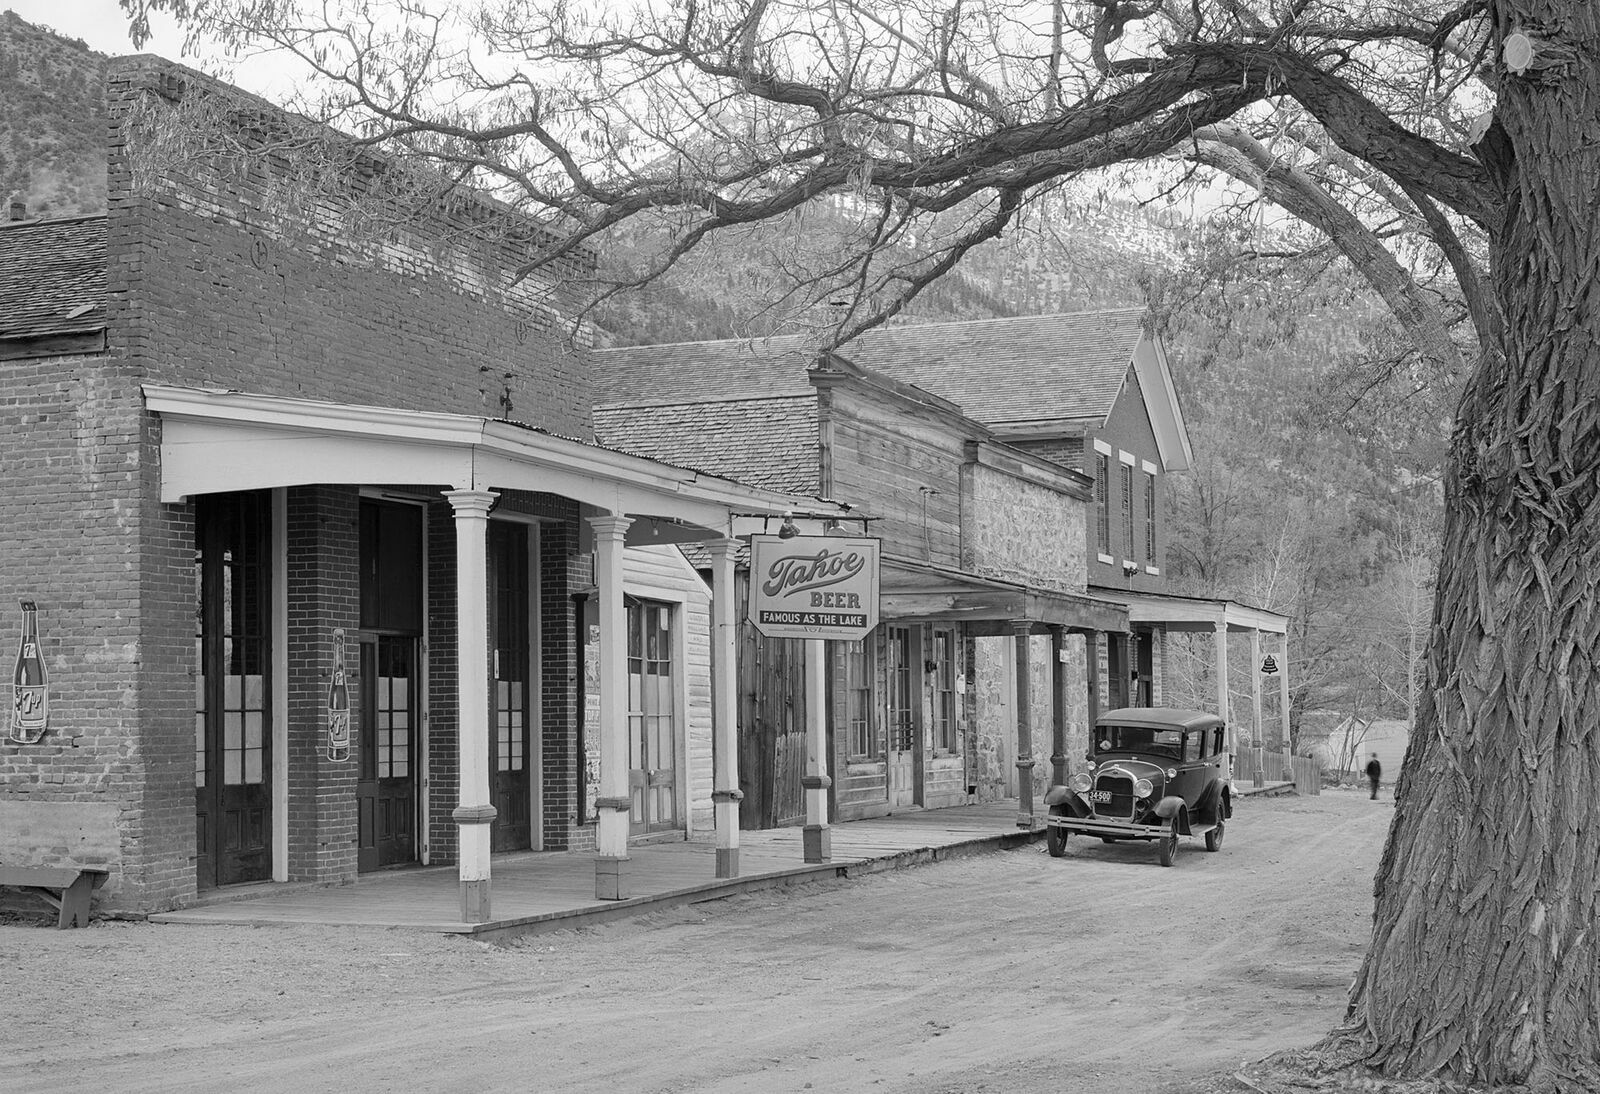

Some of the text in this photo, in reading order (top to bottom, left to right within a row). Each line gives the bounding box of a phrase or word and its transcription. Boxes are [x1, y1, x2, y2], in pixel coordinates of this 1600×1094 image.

[762, 548, 865, 598] Tahoe
[810, 591, 861, 608] BEER
[763, 612, 862, 626] FAMOUS AS THE LAKE
